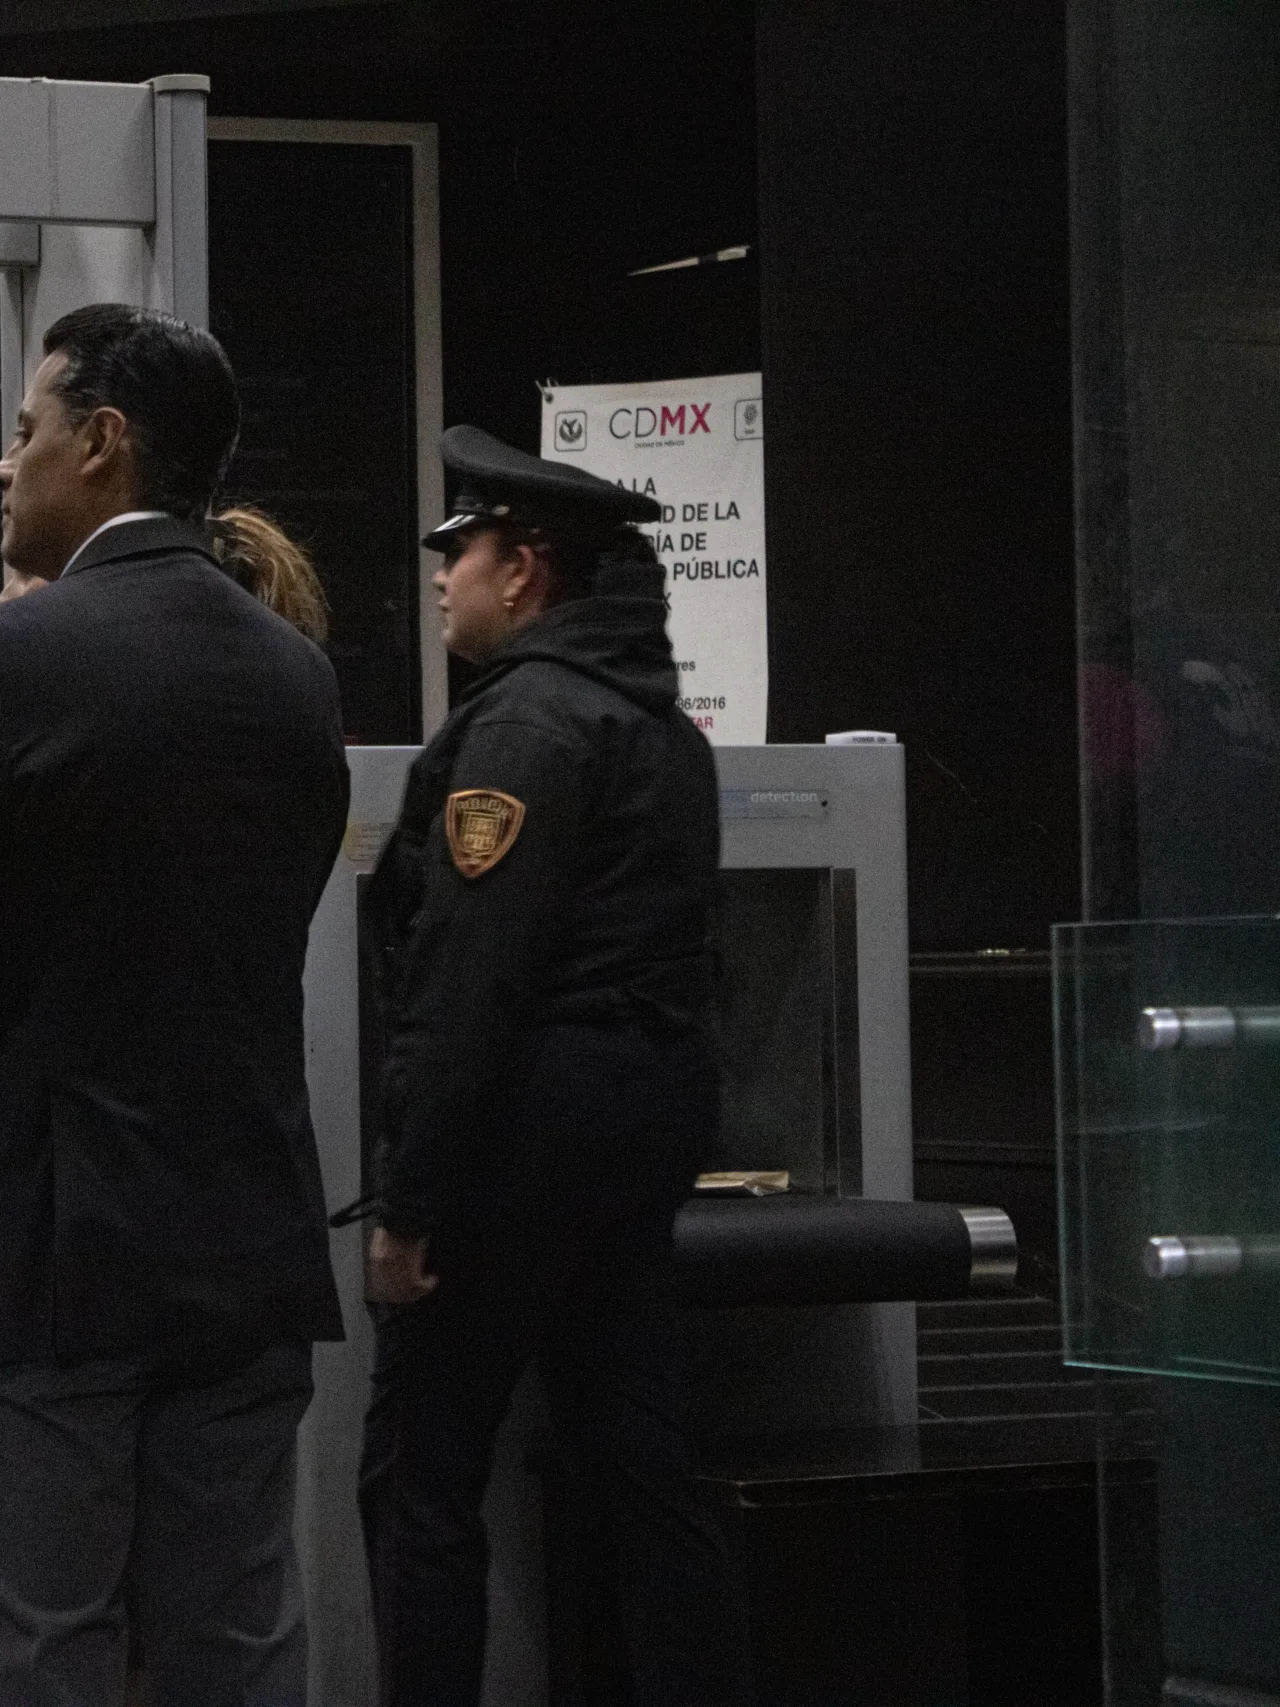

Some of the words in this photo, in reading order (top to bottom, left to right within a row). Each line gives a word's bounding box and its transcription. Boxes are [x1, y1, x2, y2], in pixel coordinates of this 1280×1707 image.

[609, 403, 712, 440] CDMX
[682, 503, 709, 522] DE
[714, 501, 741, 521] LA
[680, 532, 707, 552] DE
[673, 556, 760, 581] PÚBLICA
[750, 791, 818, 803] detection
